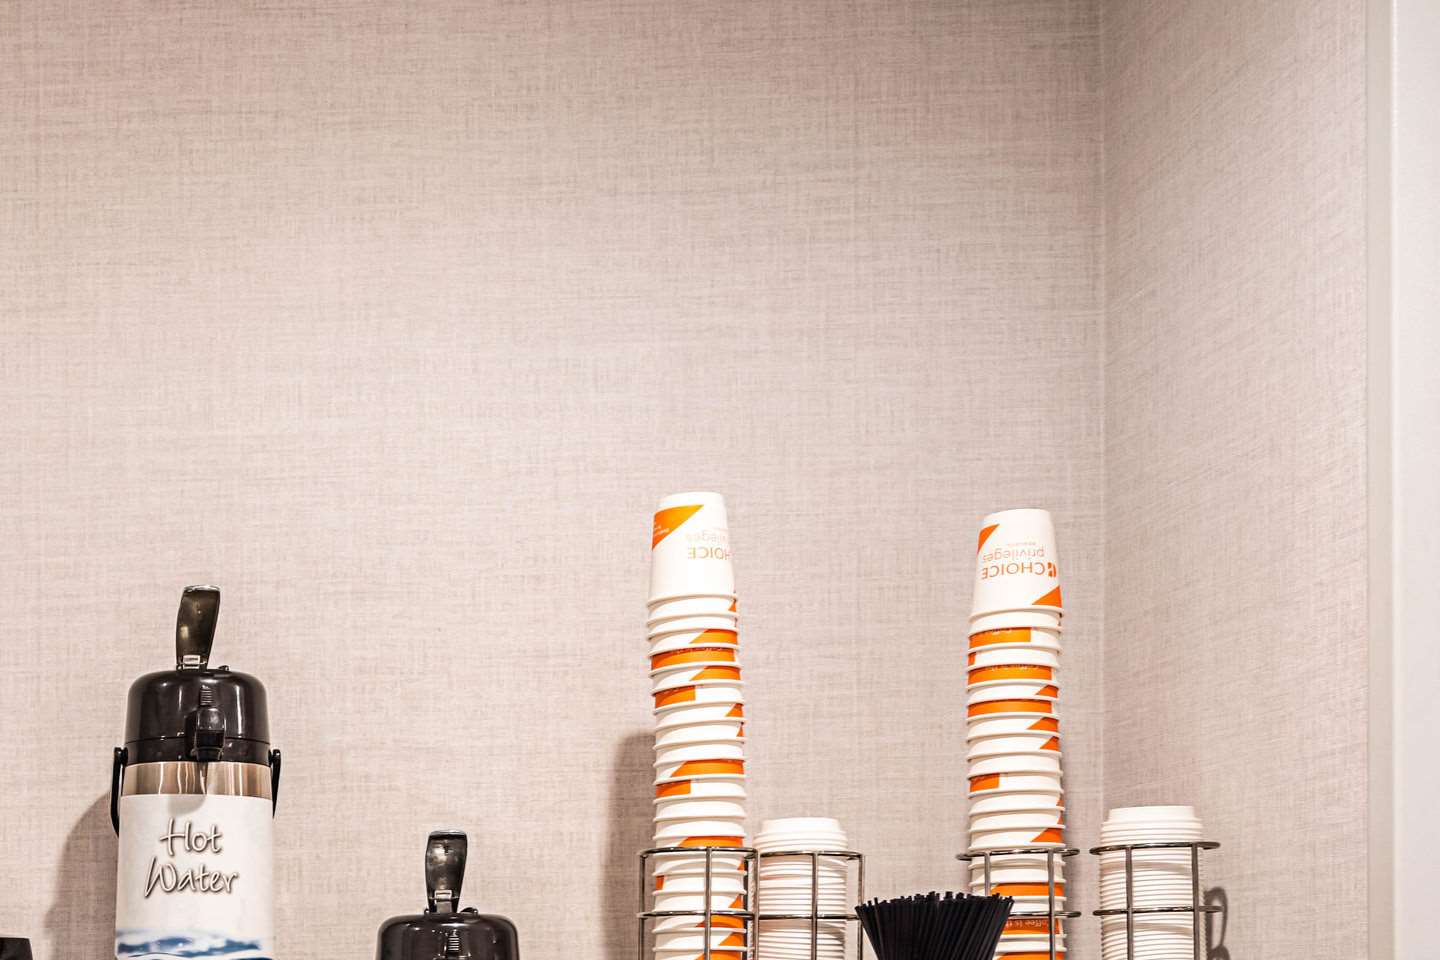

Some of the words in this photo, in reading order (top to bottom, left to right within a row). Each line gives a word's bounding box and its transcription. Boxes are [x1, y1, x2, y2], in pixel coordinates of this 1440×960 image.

[981, 562, 1045, 580] CHOICE
[159, 818, 223, 857] Hot
[144, 856, 240, 899] Water
